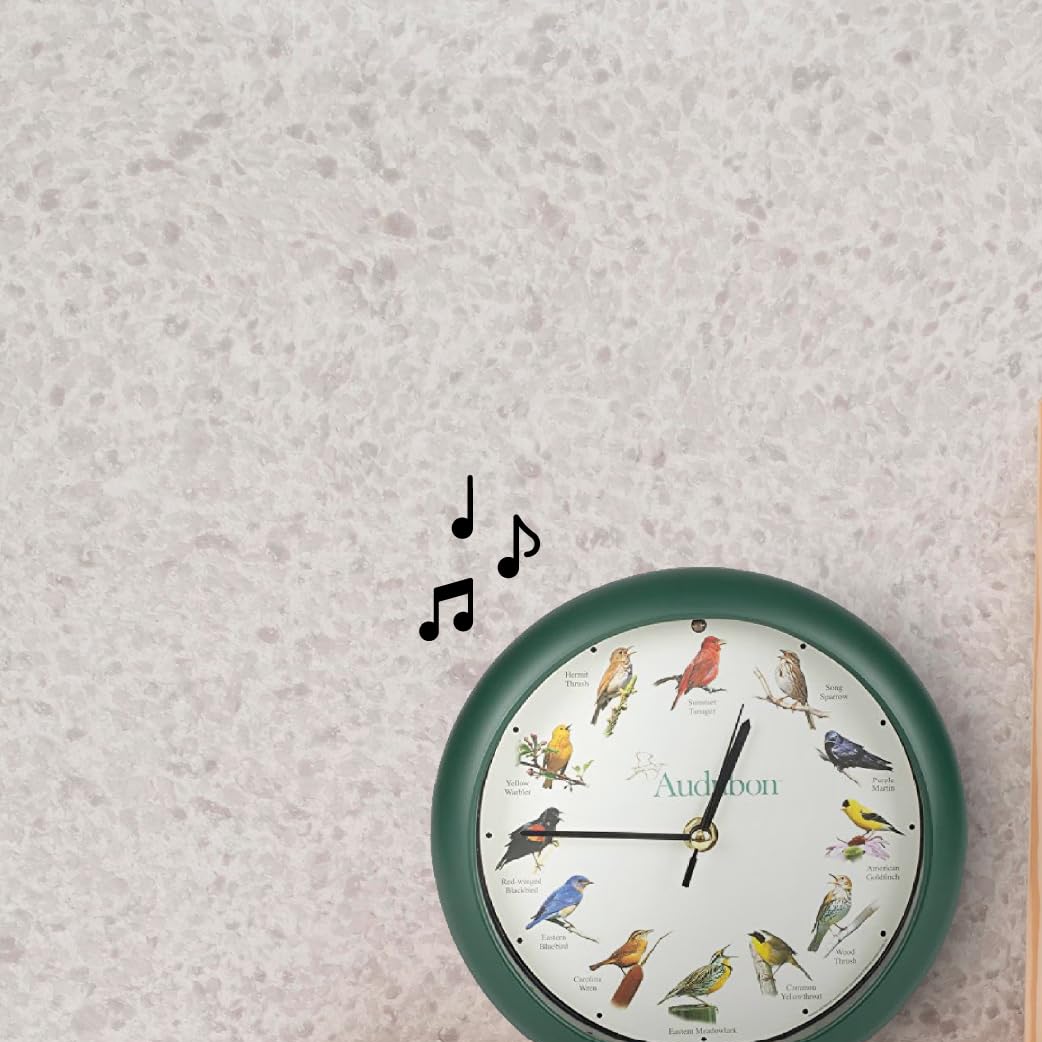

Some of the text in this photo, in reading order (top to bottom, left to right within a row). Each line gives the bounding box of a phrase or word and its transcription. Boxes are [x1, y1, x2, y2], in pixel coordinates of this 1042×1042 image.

[565, 680, 590, 688] Thrush
[825, 684, 843, 692] Song
[819, 693, 848, 701] Sparrow
[506, 779, 529, 787] Yellow
[865, 873, 900, 881] Goldfinch
